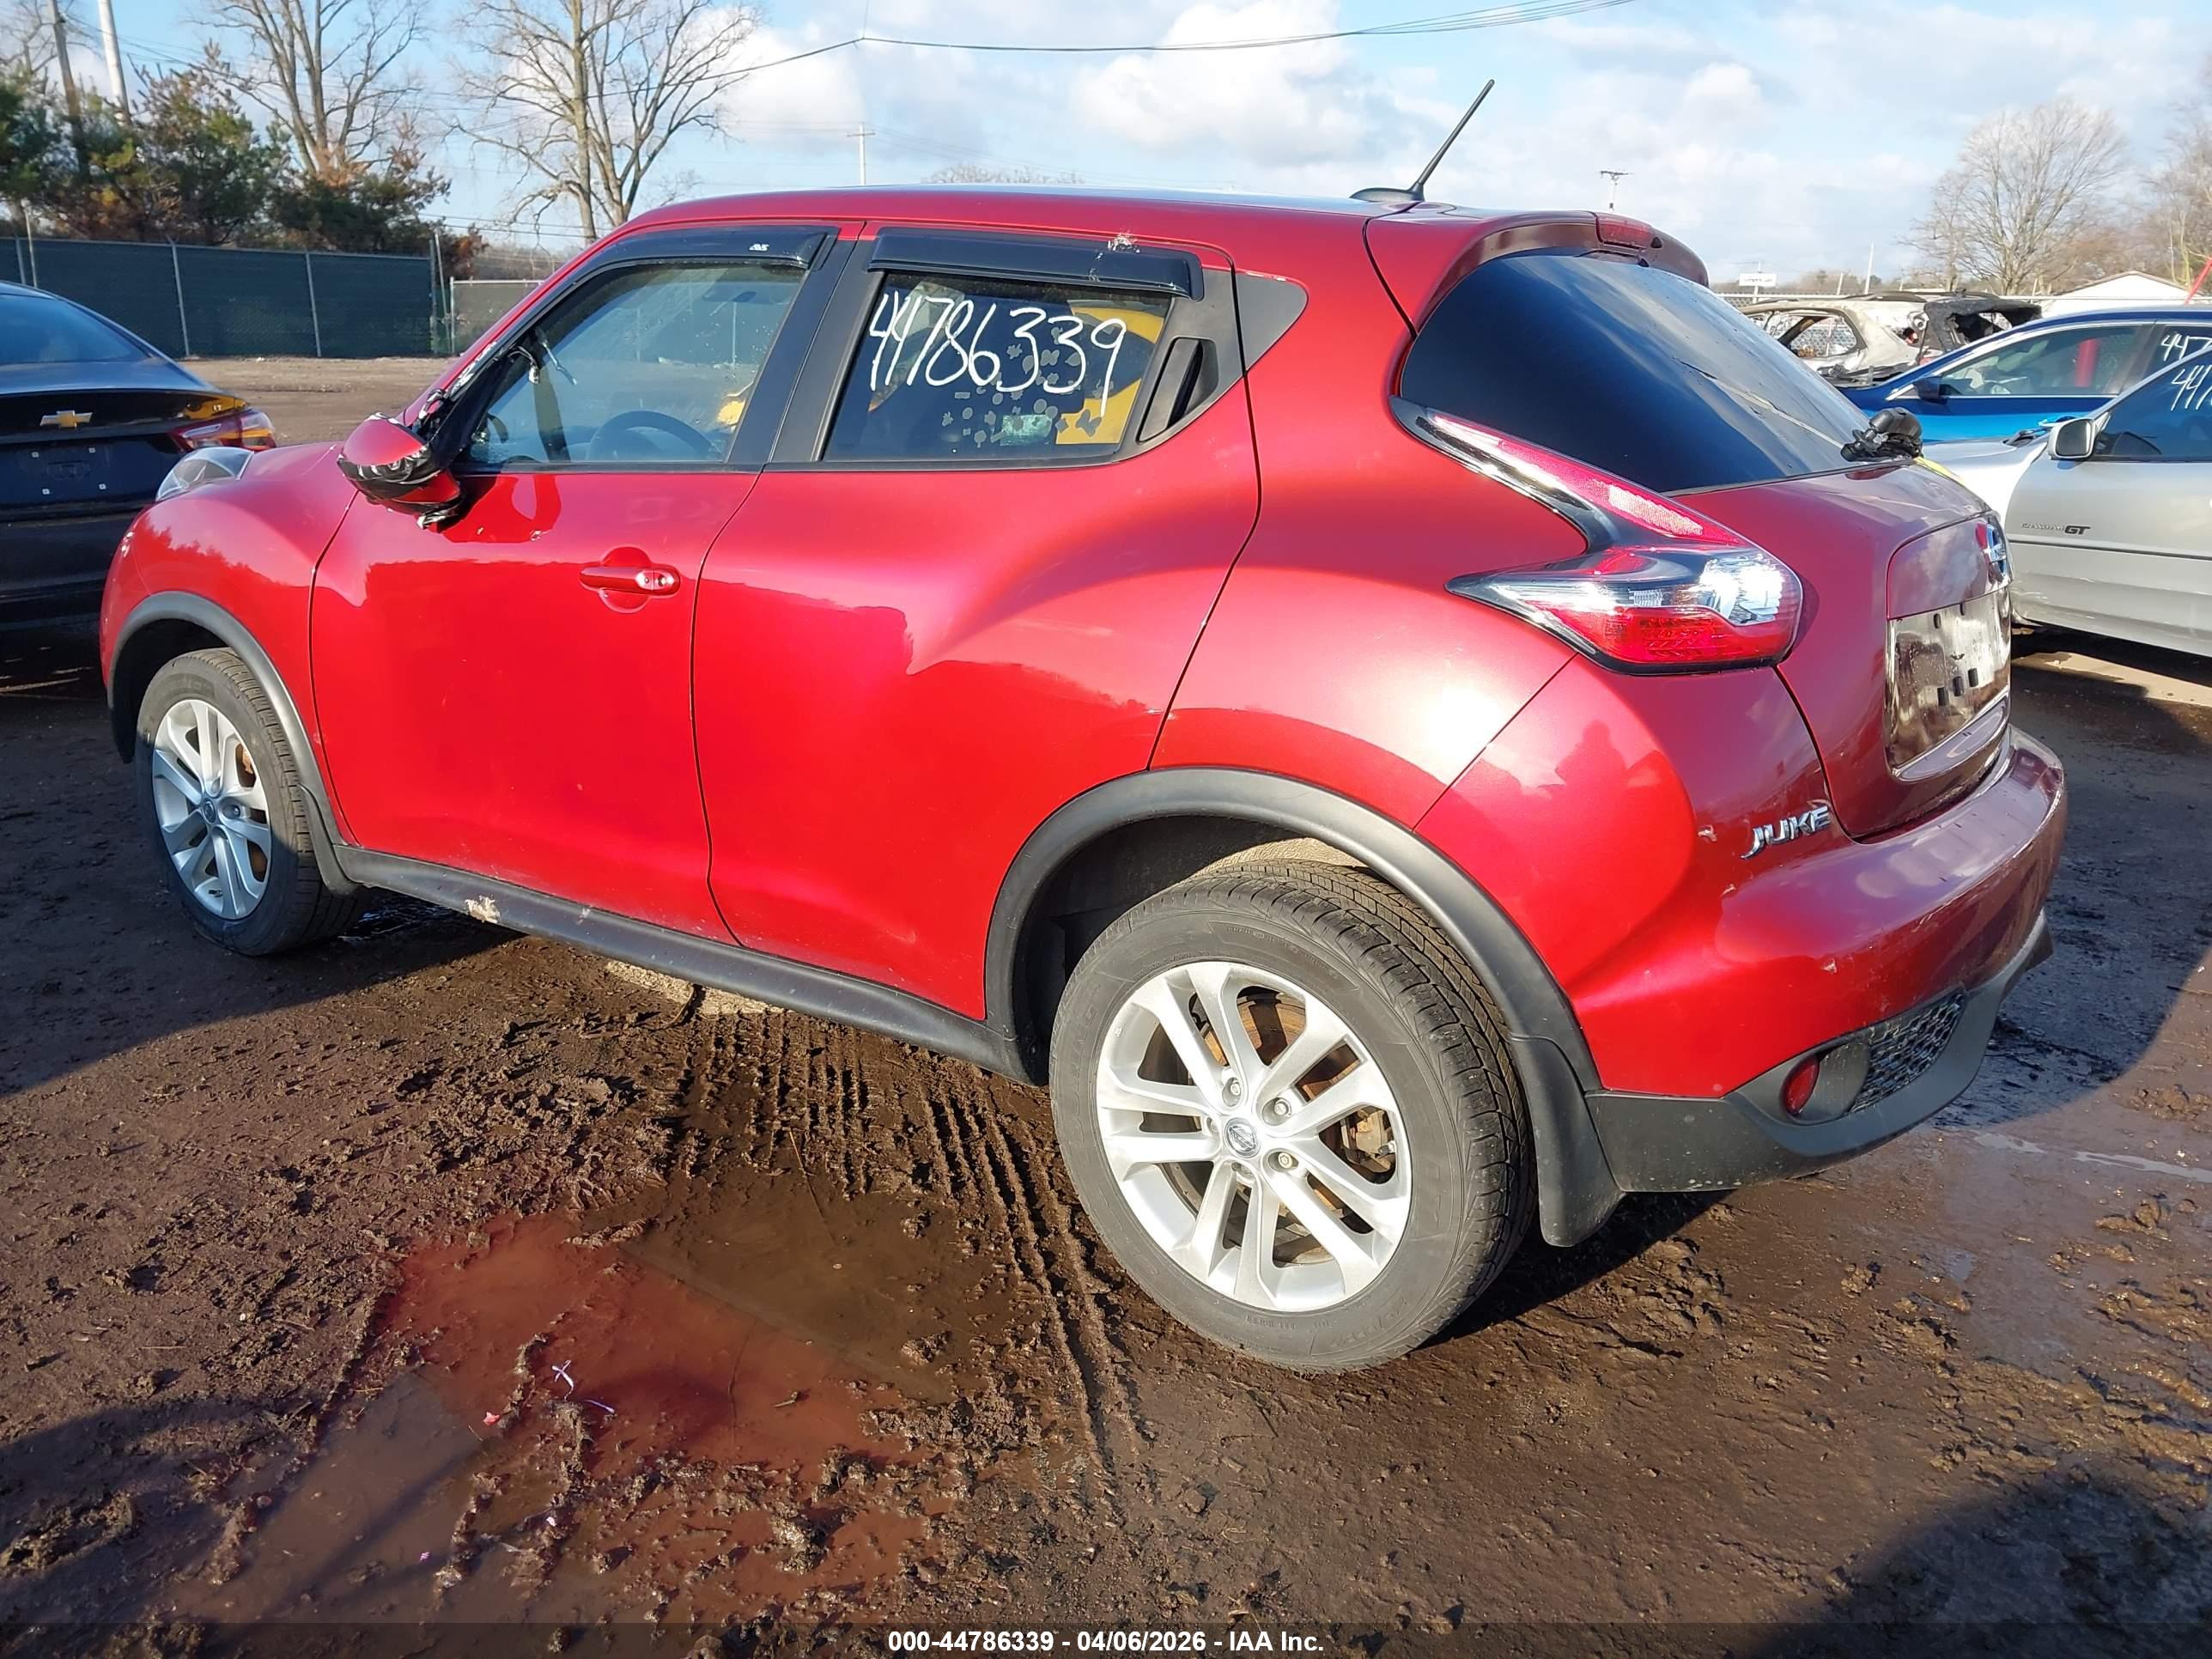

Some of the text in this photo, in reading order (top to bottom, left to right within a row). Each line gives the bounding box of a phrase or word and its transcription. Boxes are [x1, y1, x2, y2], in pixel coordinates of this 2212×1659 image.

[869, 290, 1127, 417] 44786339
[2064, 525, 2091, 535] GT
[1741, 806, 1831, 859] JUKE
